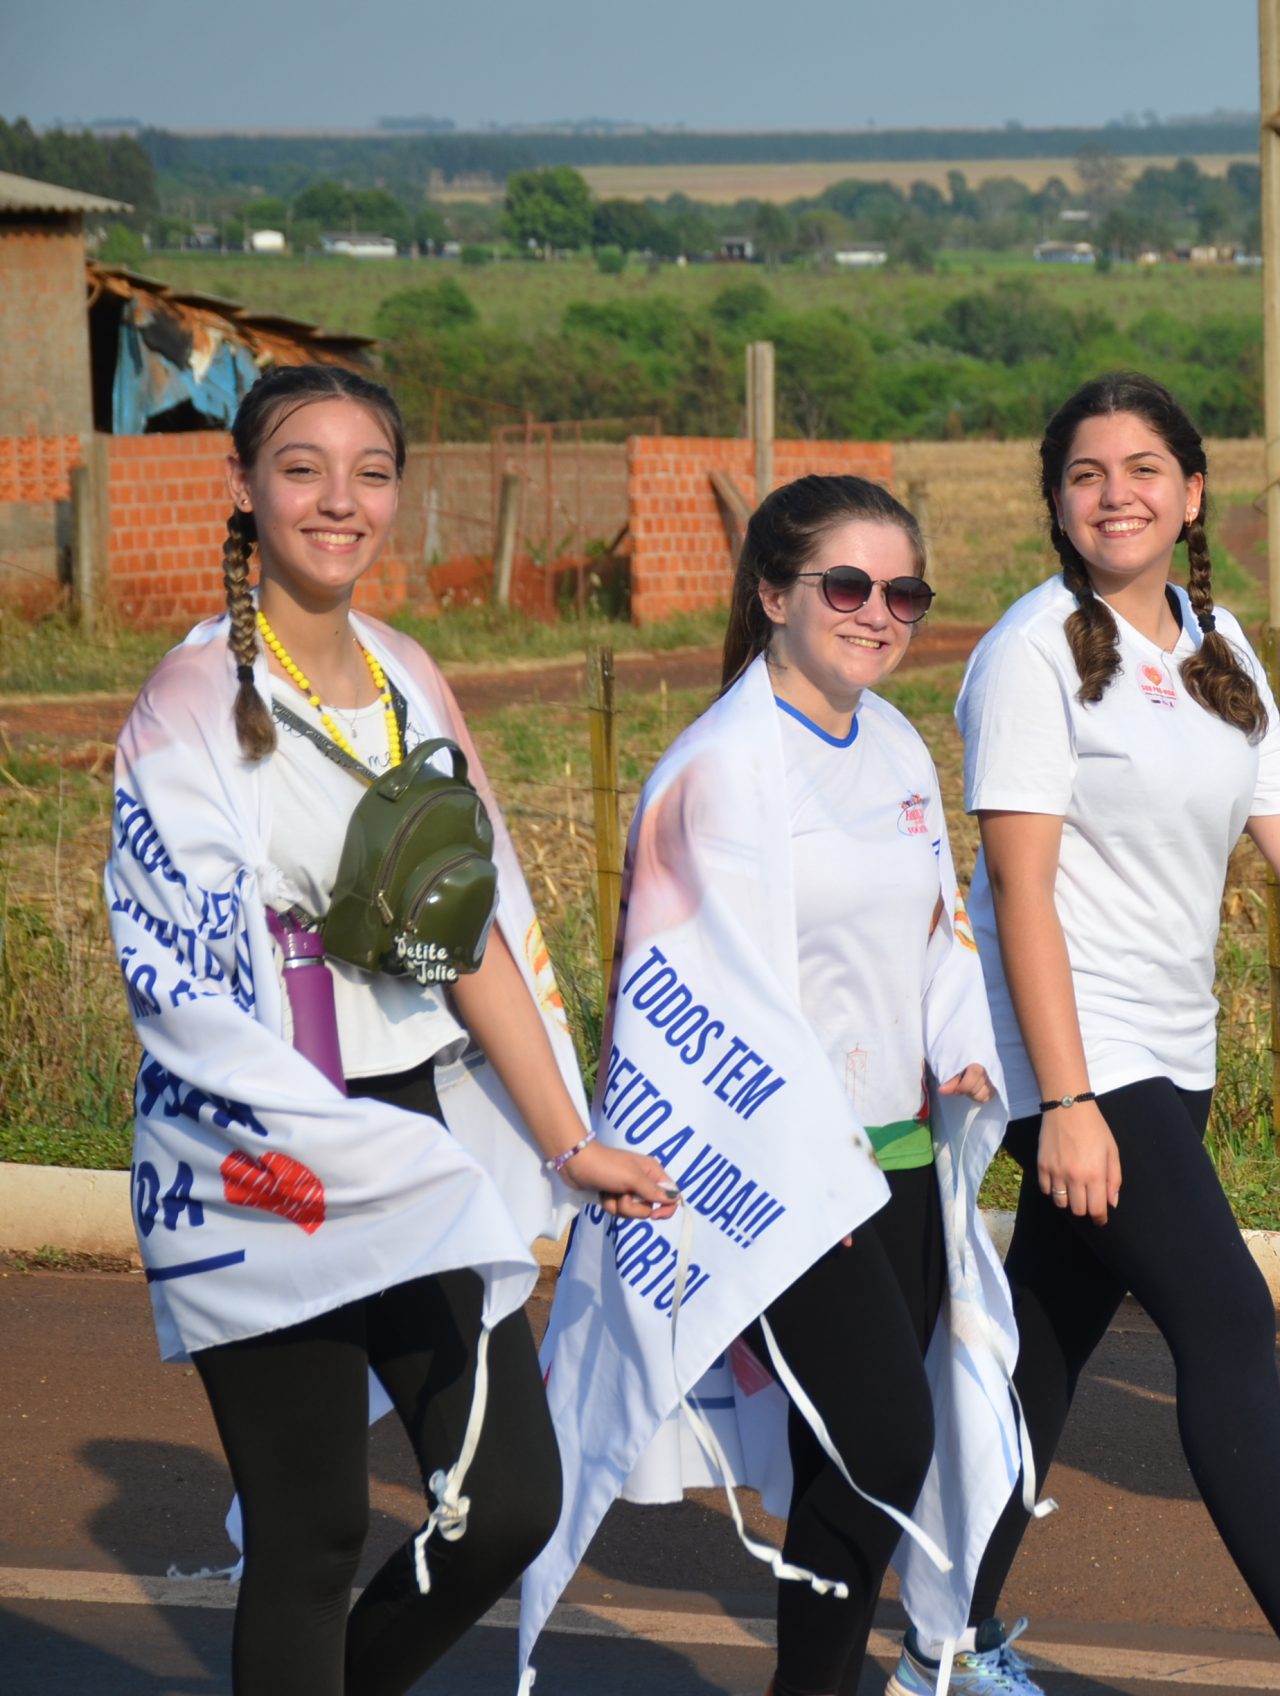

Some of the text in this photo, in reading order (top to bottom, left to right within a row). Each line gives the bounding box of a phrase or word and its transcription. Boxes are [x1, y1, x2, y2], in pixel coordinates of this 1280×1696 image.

[394, 929, 448, 960] Petite
[413, 959, 457, 984] Jolie
[622, 945, 786, 1120] TODOS TEM
[676, 1144, 786, 1249] VIDA!!!
